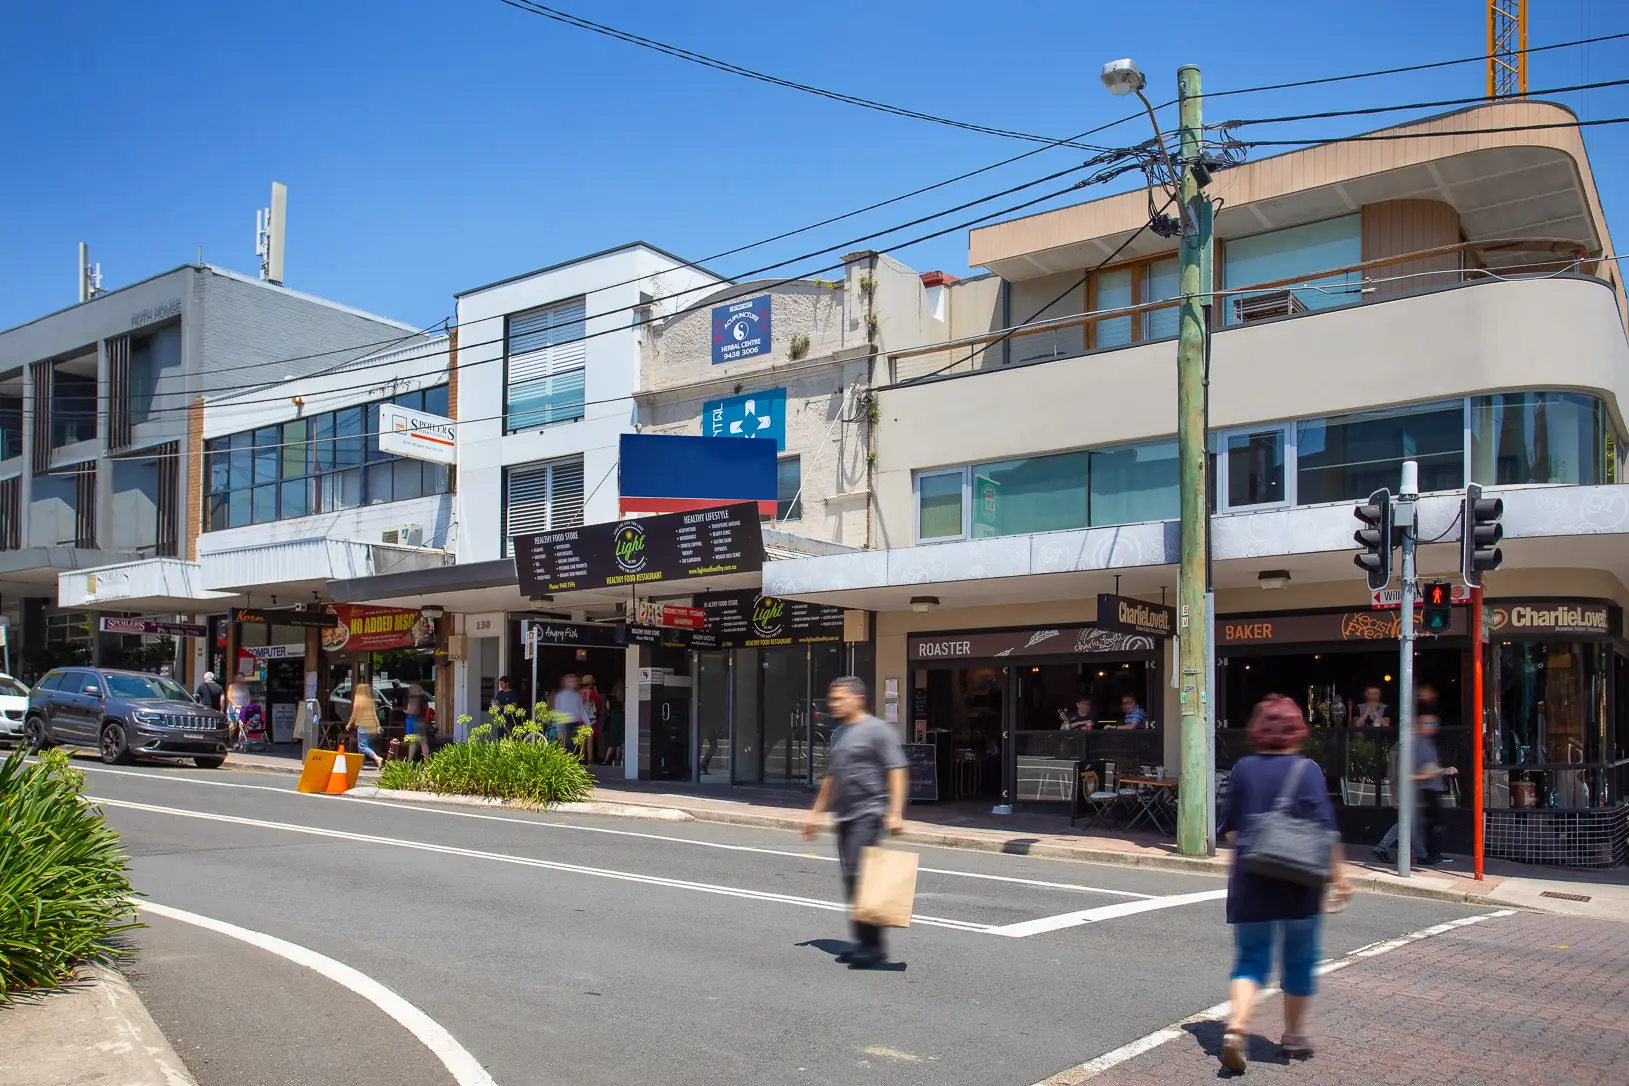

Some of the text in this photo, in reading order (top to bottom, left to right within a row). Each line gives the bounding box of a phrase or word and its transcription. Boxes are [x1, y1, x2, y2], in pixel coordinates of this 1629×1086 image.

[725, 312, 759, 329] ACUPUNCTURE
[721, 338, 761, 352] HERBAL CENTRE
[724, 351, 740, 359] 9438
[684, 510, 729, 524] HEALTHY LIFESTYLE
[534, 531, 578, 545] HEALTHY FOOD STORE
[616, 535, 645, 561] Light
[606, 571, 662, 584] HEALTHY FOOD RESTAURANT
[752, 602, 783, 626] Light
[1119, 601, 1169, 630] CharlieLovett
[1511, 606, 1608, 629] CharlieLovett
[107, 619, 145, 630] SPOILERS
[351, 619, 363, 634] NO
[364, 615, 393, 633] ADDED
[476, 621, 490, 629] 130
[1353, 612, 1392, 634] Yeast
[545, 626, 578, 642] Angry Fish
[1225, 623, 1272, 640] BAKER
[919, 641, 971, 657] ROASTER
